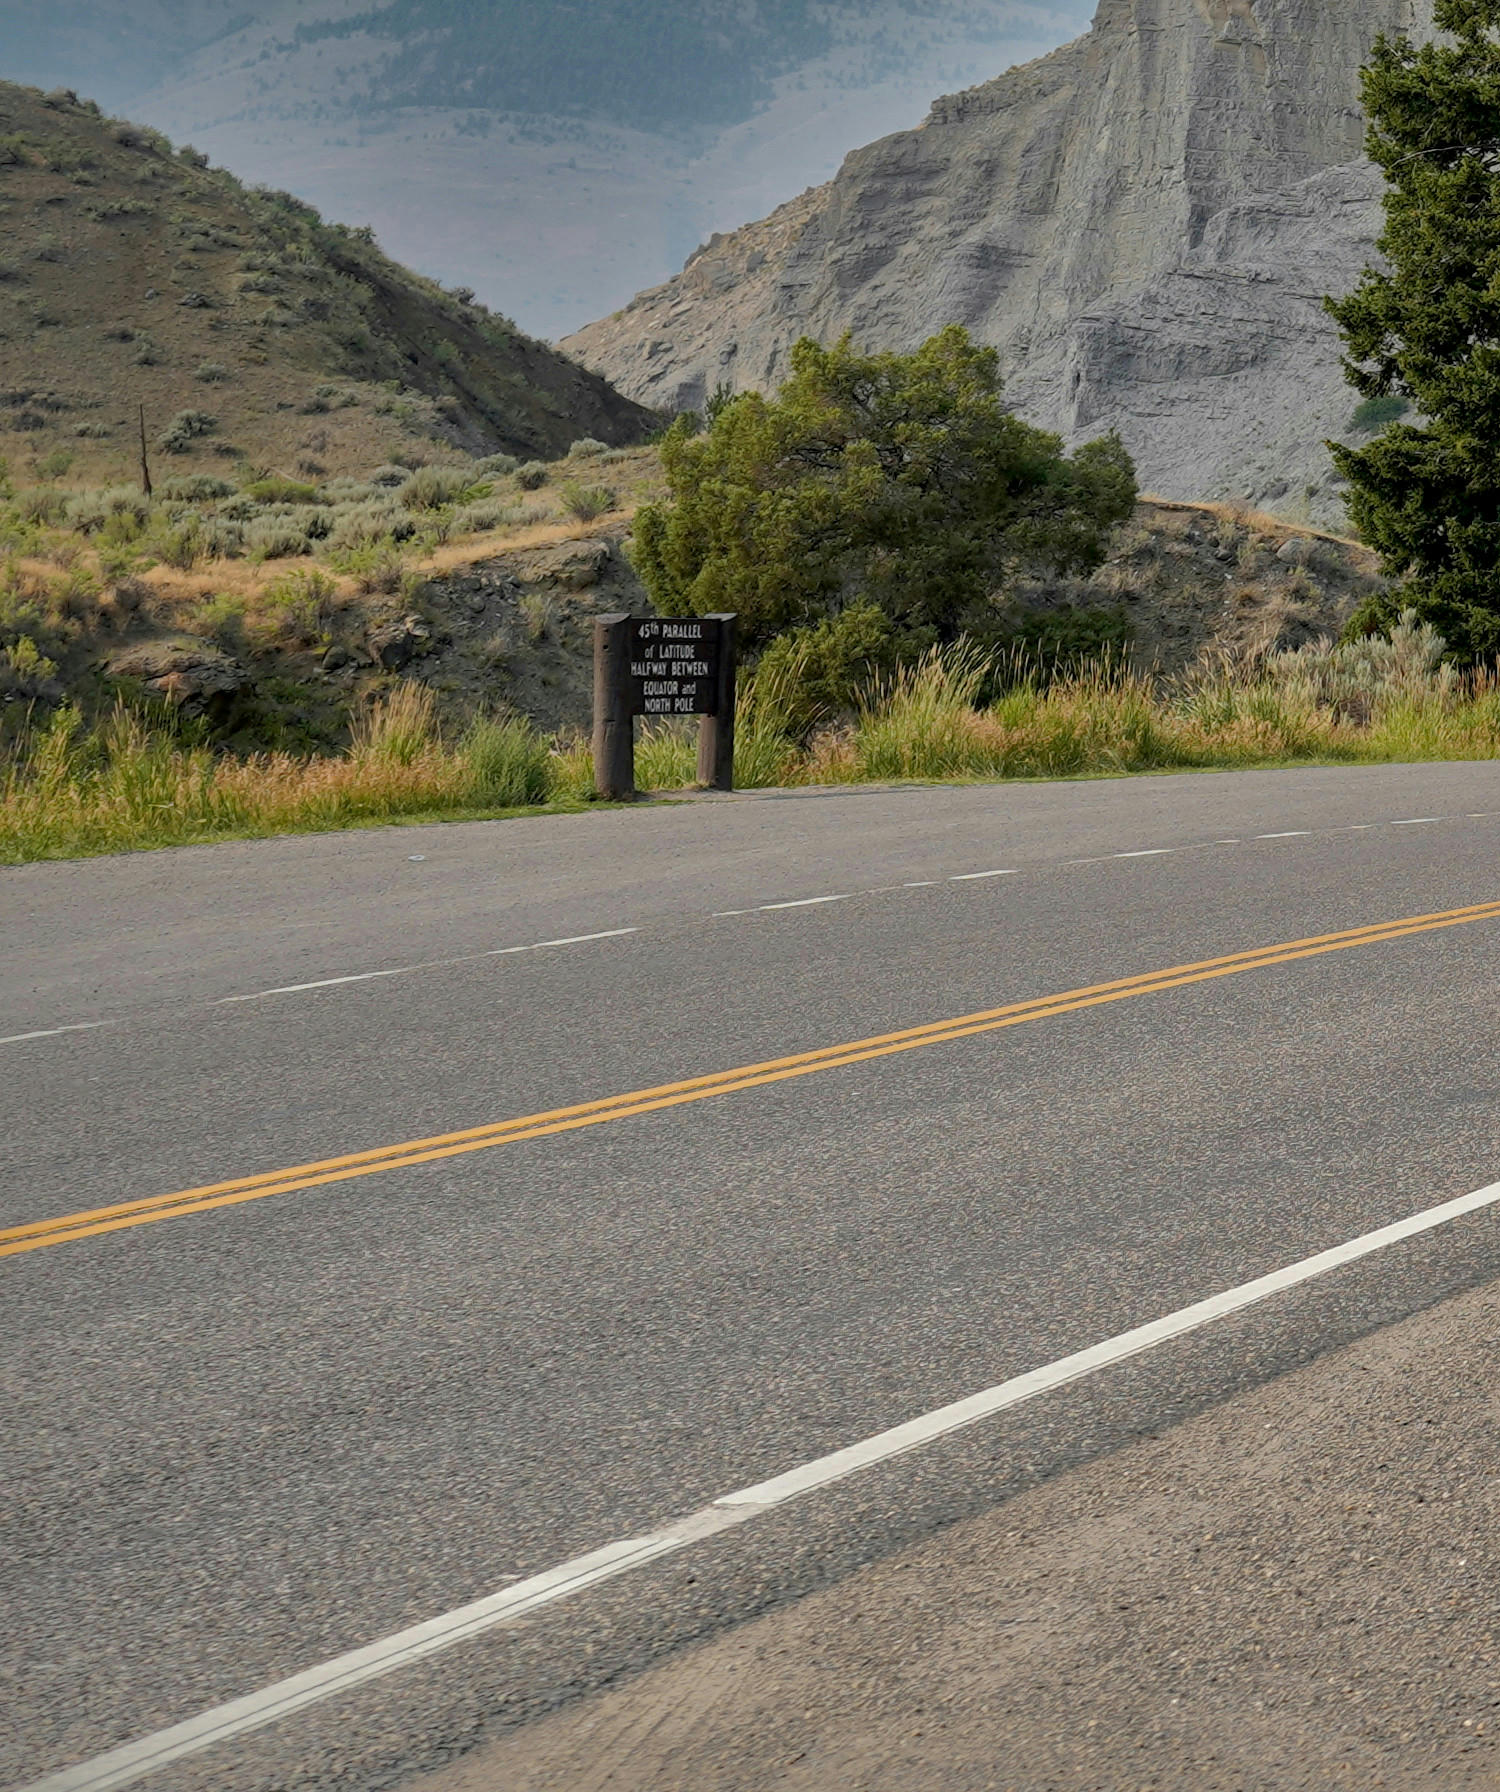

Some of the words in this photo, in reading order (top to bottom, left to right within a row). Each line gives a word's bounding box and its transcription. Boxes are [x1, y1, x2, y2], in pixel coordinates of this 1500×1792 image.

[638, 622, 659, 638] 45th
[663, 624, 702, 638] PARALLEL
[645, 645, 654, 658] of
[659, 645, 695, 659] LATITUDE
[631, 662, 666, 675] HALFWAY
[671, 662, 708, 675] BETWEEN
[643, 681, 678, 695] EQUATOR
[682, 682, 696, 695] and
[645, 698, 670, 712] NORTH
[675, 698, 694, 712] POLE
